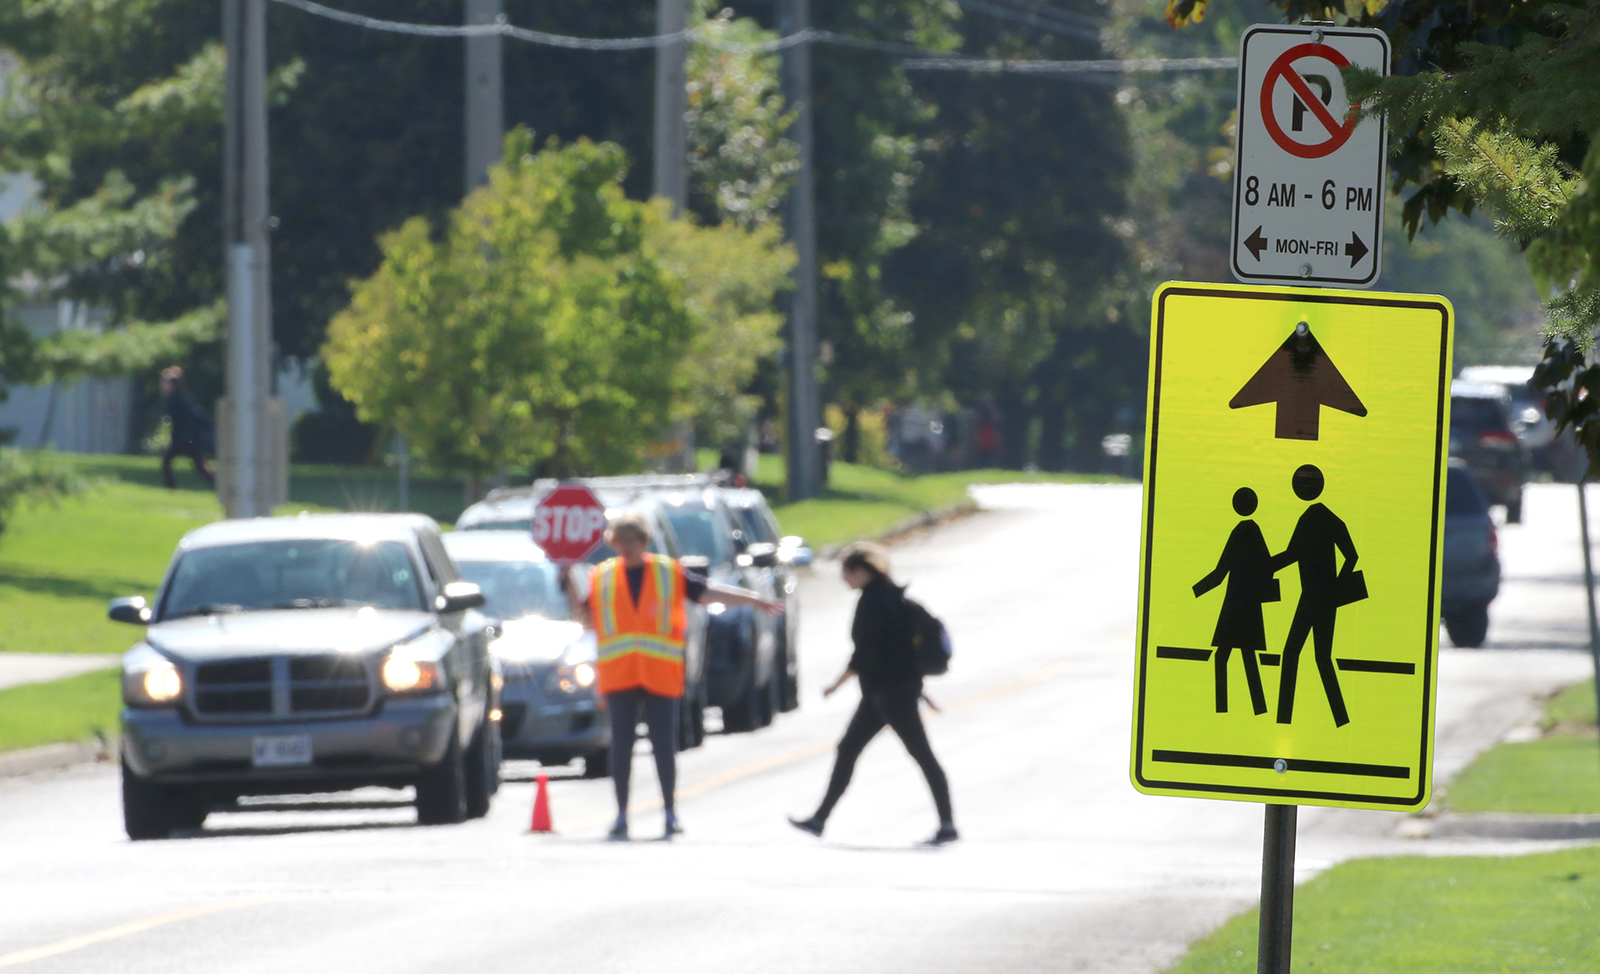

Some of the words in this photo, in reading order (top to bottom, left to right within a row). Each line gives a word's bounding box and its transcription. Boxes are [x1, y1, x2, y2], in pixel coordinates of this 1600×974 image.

[1292, 74, 1332, 131] P
[1244, 175, 1260, 206] 8
[1267, 183, 1296, 207] AM
[1321, 179, 1336, 210] 6
[1345, 187, 1373, 212] PM
[1275, 238, 1338, 256] MON-FRI
[533, 504, 603, 543] STOP
